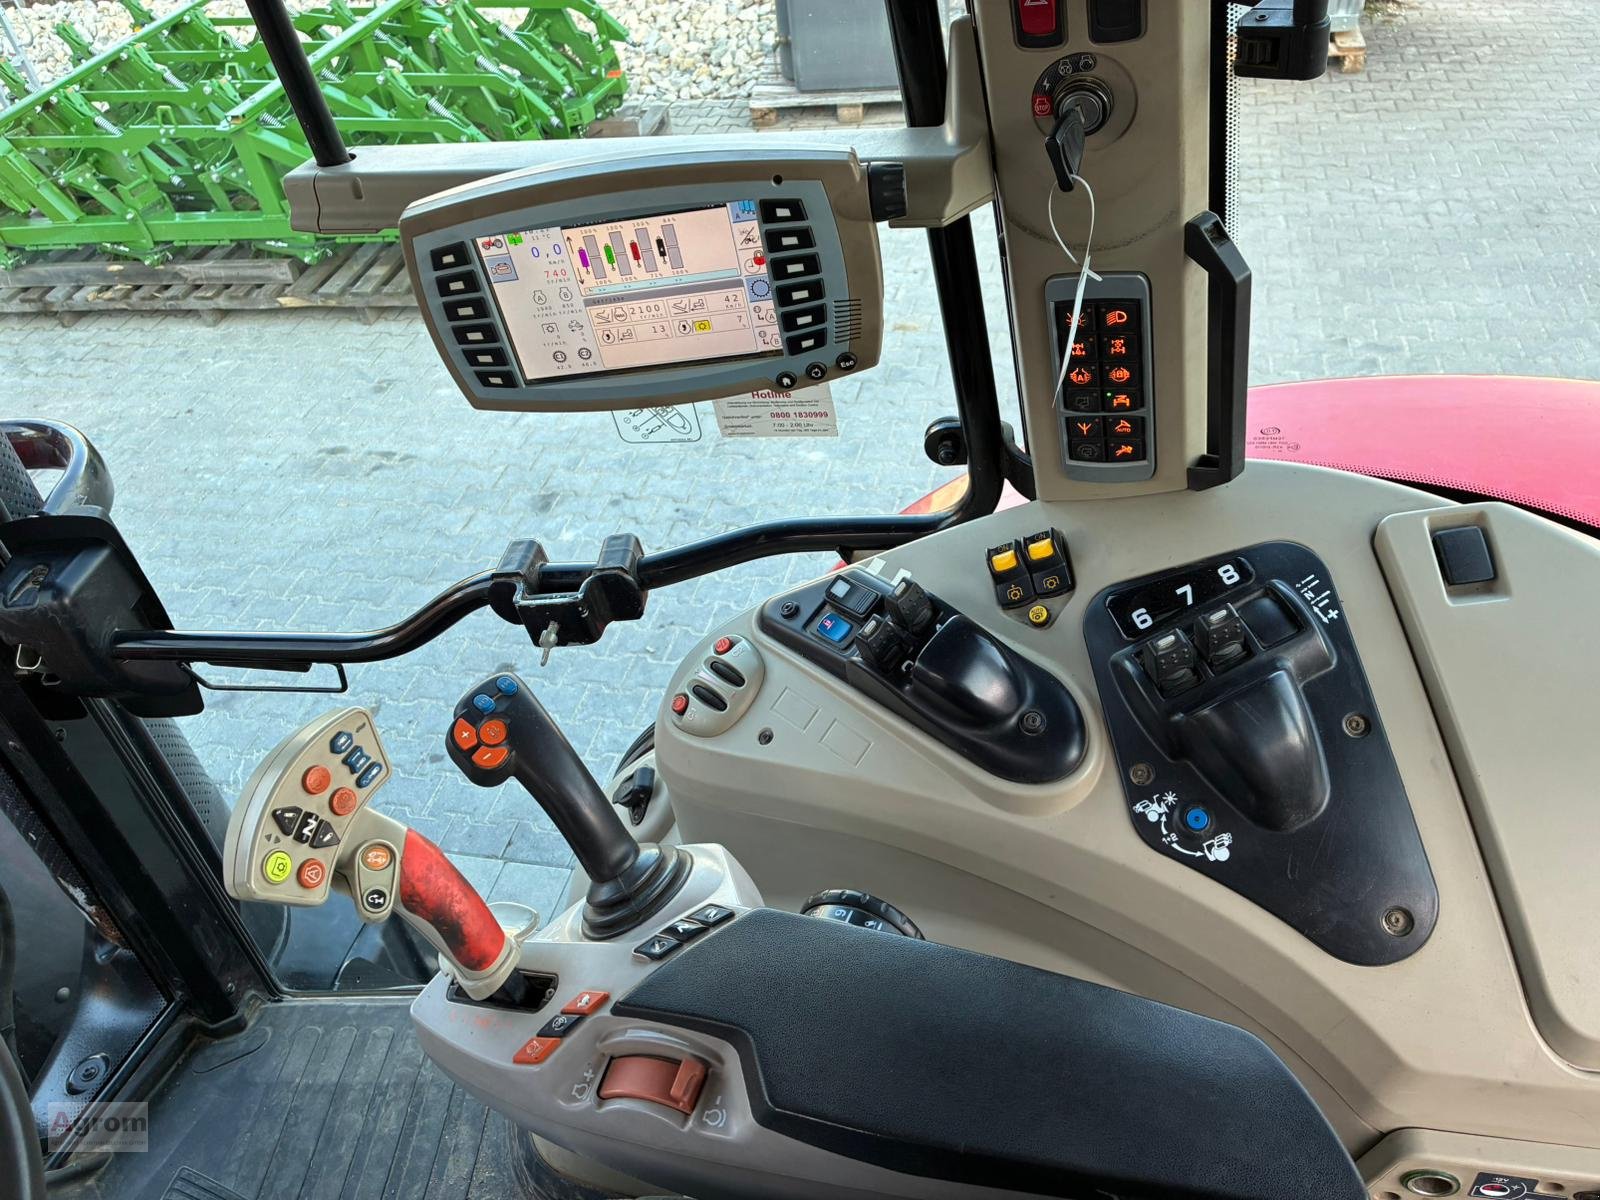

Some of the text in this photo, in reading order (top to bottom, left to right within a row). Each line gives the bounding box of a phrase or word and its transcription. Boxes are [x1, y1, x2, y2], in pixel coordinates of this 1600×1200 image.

[544, 268, 567, 278] 740
[724, 294, 738, 302] 42
[630, 304, 660, 314] 2100
[737, 315, 742, 323] 7
[652, 325, 666, 334] 13
[840, 360, 854, 368] Esc
[752, 390, 792, 399] Hotline
[770, 411, 790, 419] 0800
[794, 410, 828, 419] 1830999
[1131, 564, 1240, 630] 6 7 8
